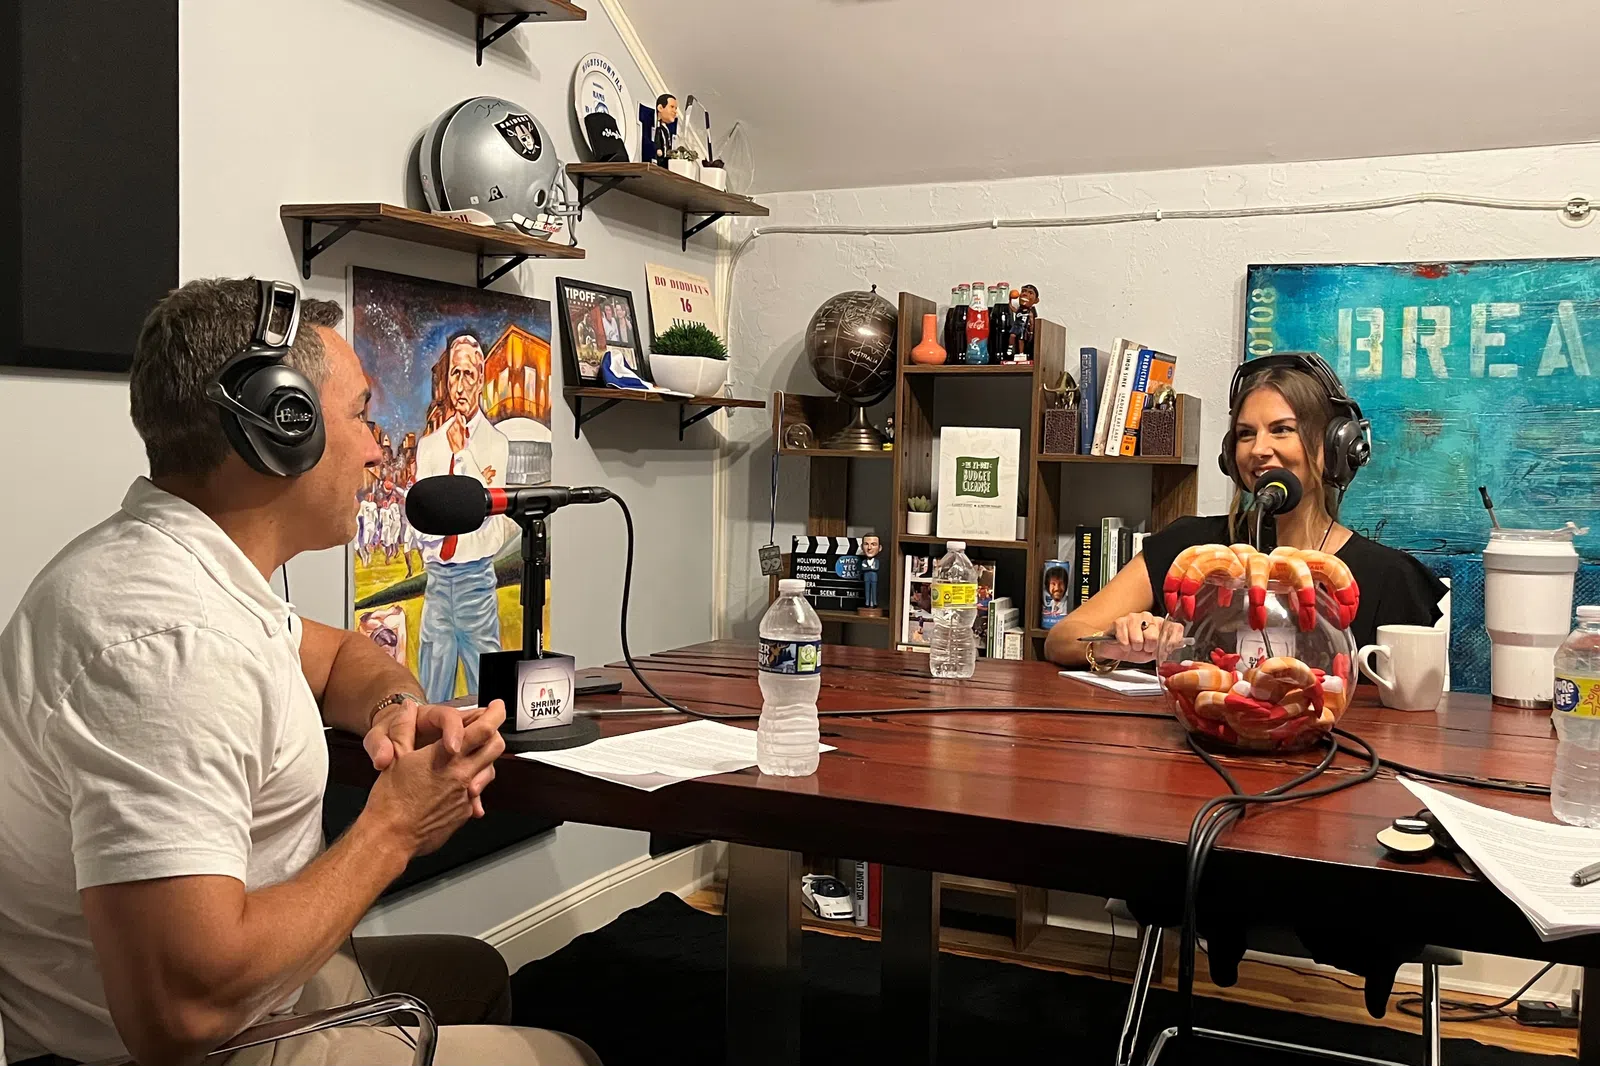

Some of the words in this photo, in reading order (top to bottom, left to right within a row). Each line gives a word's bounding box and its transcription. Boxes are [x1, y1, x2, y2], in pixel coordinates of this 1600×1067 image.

[499, 115, 530, 129] RAIDERS
[654, 275, 667, 287] BO
[669, 279, 711, 296] DIDDLEY'S
[564, 286, 596, 304] TIPOFF
[679, 297, 693, 313] 16
[1337, 298, 1593, 379] BREA
[850, 349, 878, 364] AUSTRALIA
[1124, 353, 1132, 371] SIMON
[1121, 371, 1129, 388] SINEK
[1138, 354, 1150, 391] PREDICTABLY
[963, 469, 992, 482] BUDGET
[1083, 532, 1092, 549] TOOLS
[761, 557, 781, 572] 99
[796, 557, 827, 565] HOLLYWOOD
[1082, 557, 1090, 575] TITANS
[796, 565, 828, 573] PRODUCTION
[819, 589, 836, 597] SCENE
[758, 642, 770, 654] ER
[758, 654, 770, 665] RK
[530, 698, 561, 709] SHRIMP
[530, 705, 561, 717] TANK
[856, 870, 865, 901] INVESTOR
